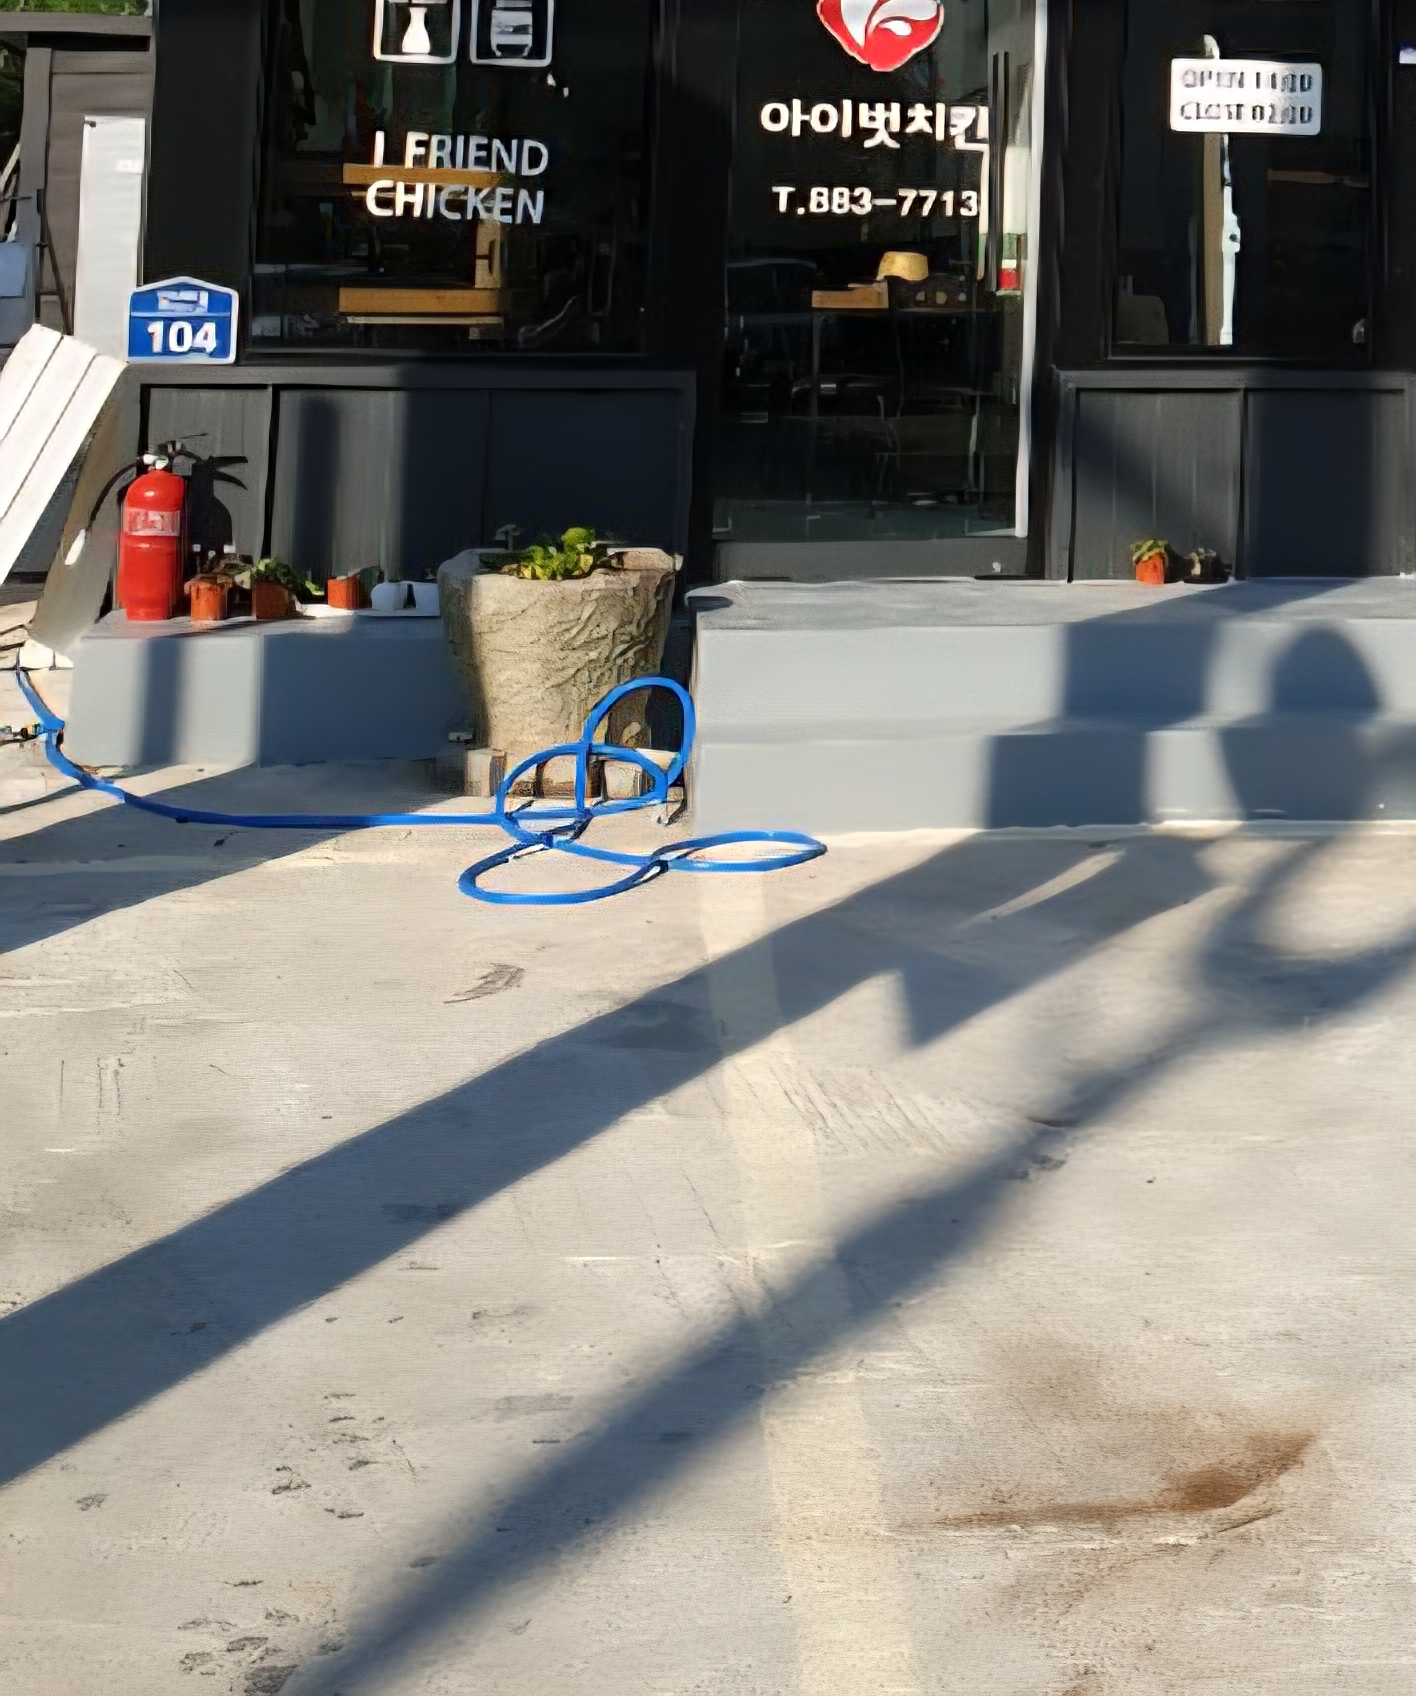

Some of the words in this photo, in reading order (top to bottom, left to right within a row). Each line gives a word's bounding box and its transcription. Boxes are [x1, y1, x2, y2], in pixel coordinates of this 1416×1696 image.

[760, 99, 989, 150] 아이벗치킨
[405, 131, 549, 176] FRIEND
[365, 179, 545, 224] CHICKEN
[772, 184, 980, 217] T.883-7713
[147, 319, 217, 353] 104
